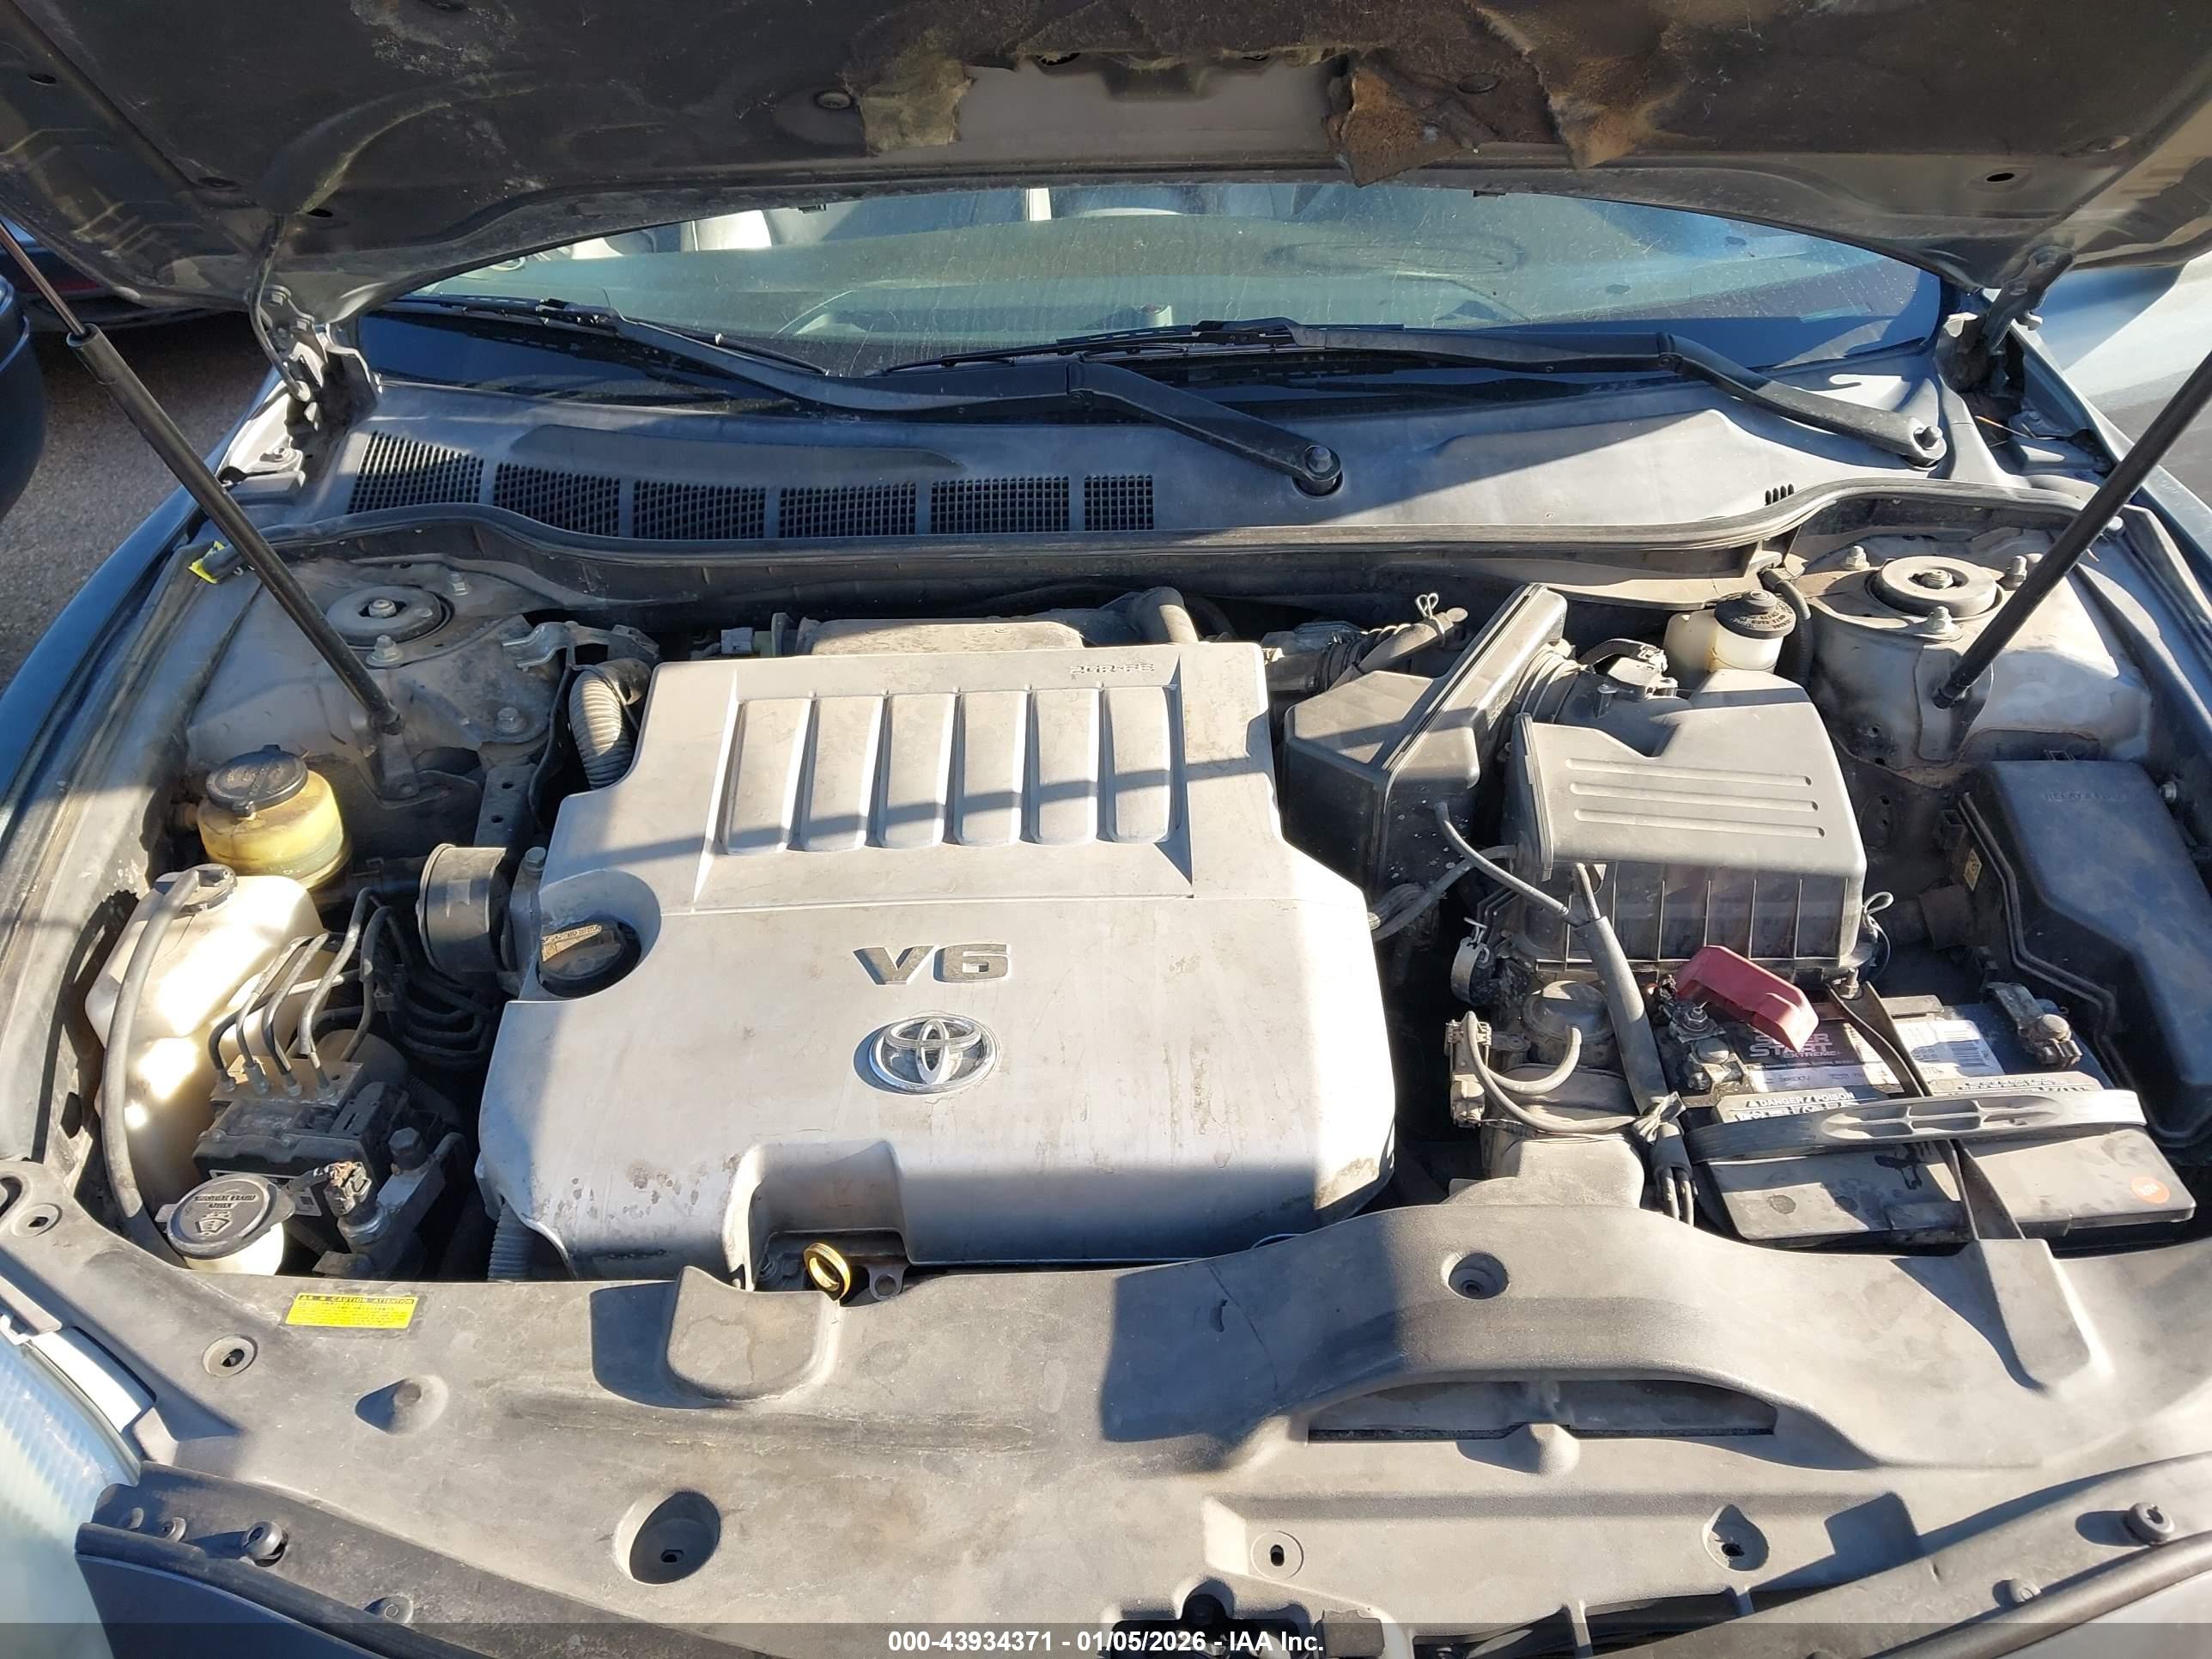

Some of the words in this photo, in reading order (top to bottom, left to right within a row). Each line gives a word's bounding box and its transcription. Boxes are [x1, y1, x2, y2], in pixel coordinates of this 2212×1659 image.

[853, 944, 1010, 985] V6
[1760, 1096, 1804, 1108] DANGER
[1815, 1091, 1856, 1103] POISON
